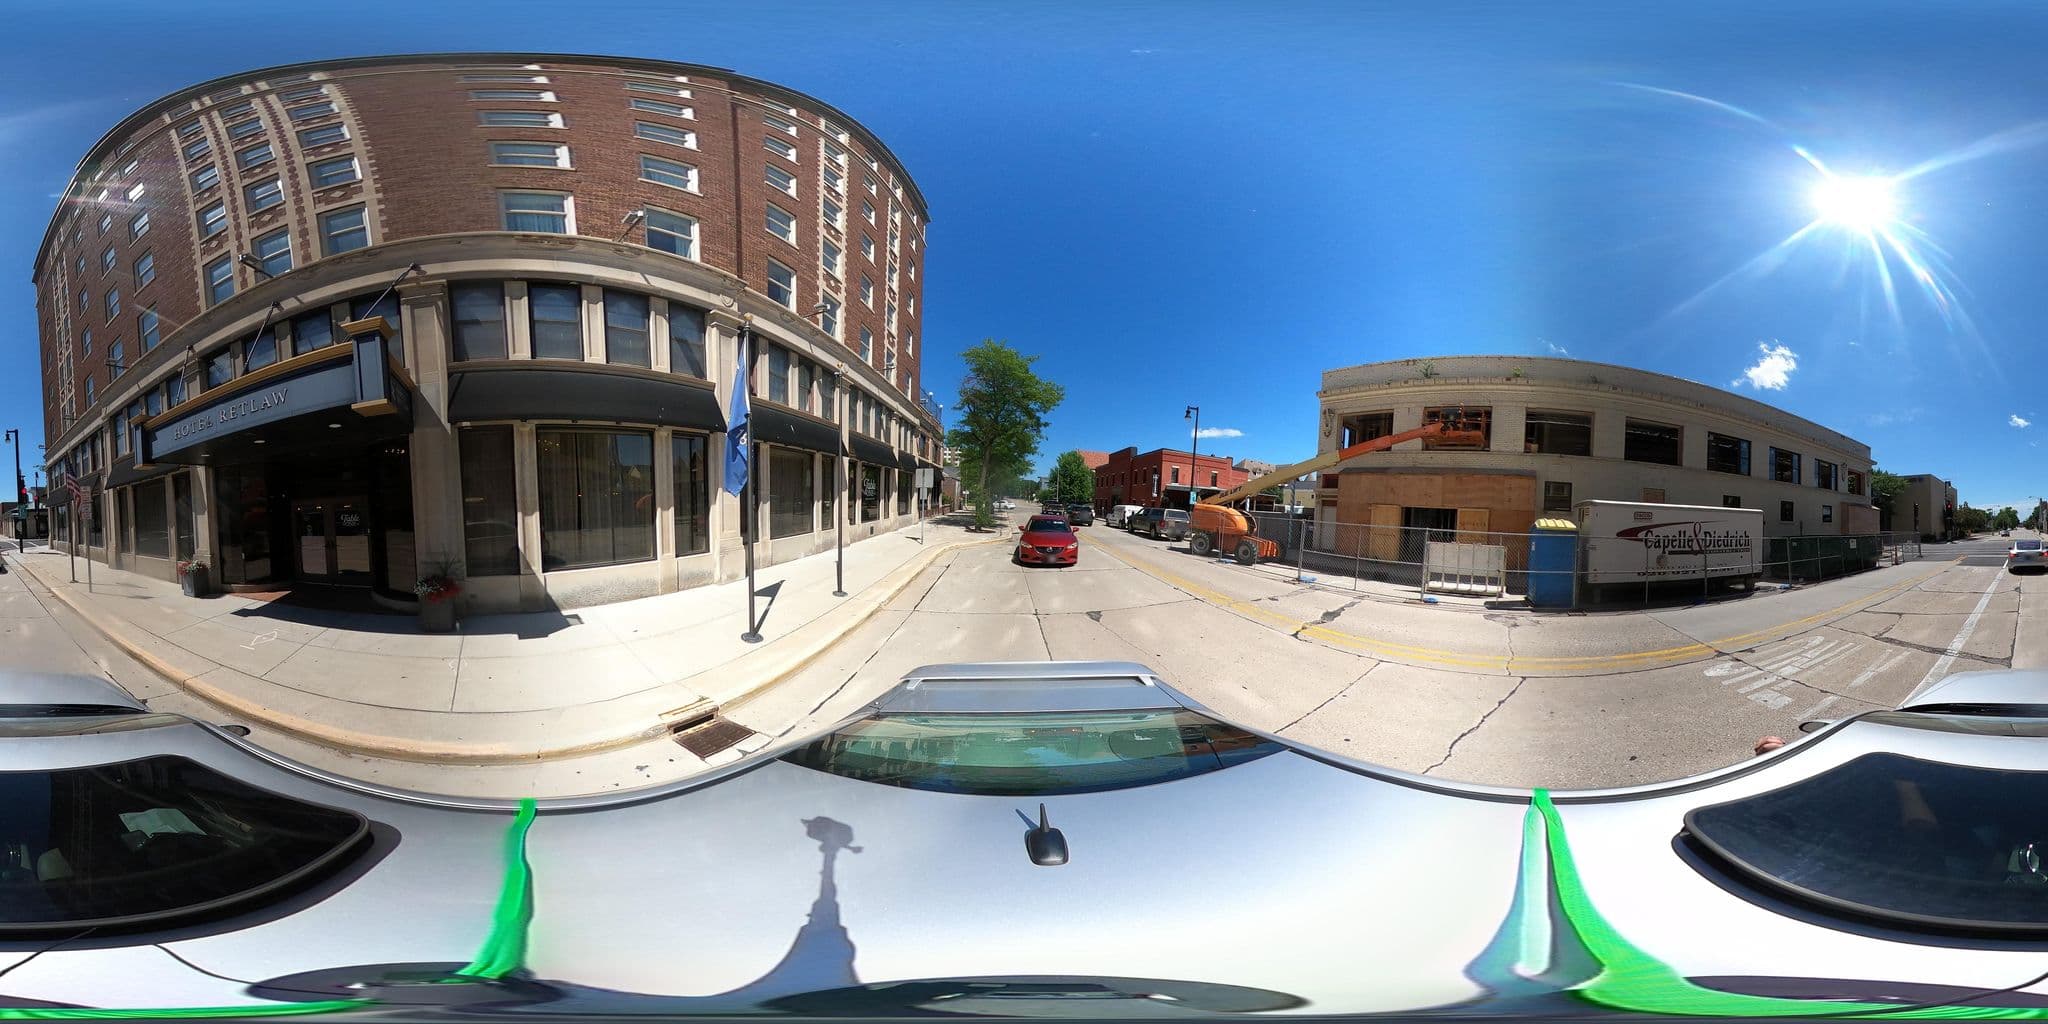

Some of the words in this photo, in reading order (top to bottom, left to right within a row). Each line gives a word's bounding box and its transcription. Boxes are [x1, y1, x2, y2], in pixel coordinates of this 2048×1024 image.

[174, 416, 214, 441] HOTEL
[219, 388, 288, 424] RETLAW
[1643, 530, 1693, 554] Capelle
[1703, 530, 1750, 549] Diedrich
[1703, 634, 1912, 723] ONLY
